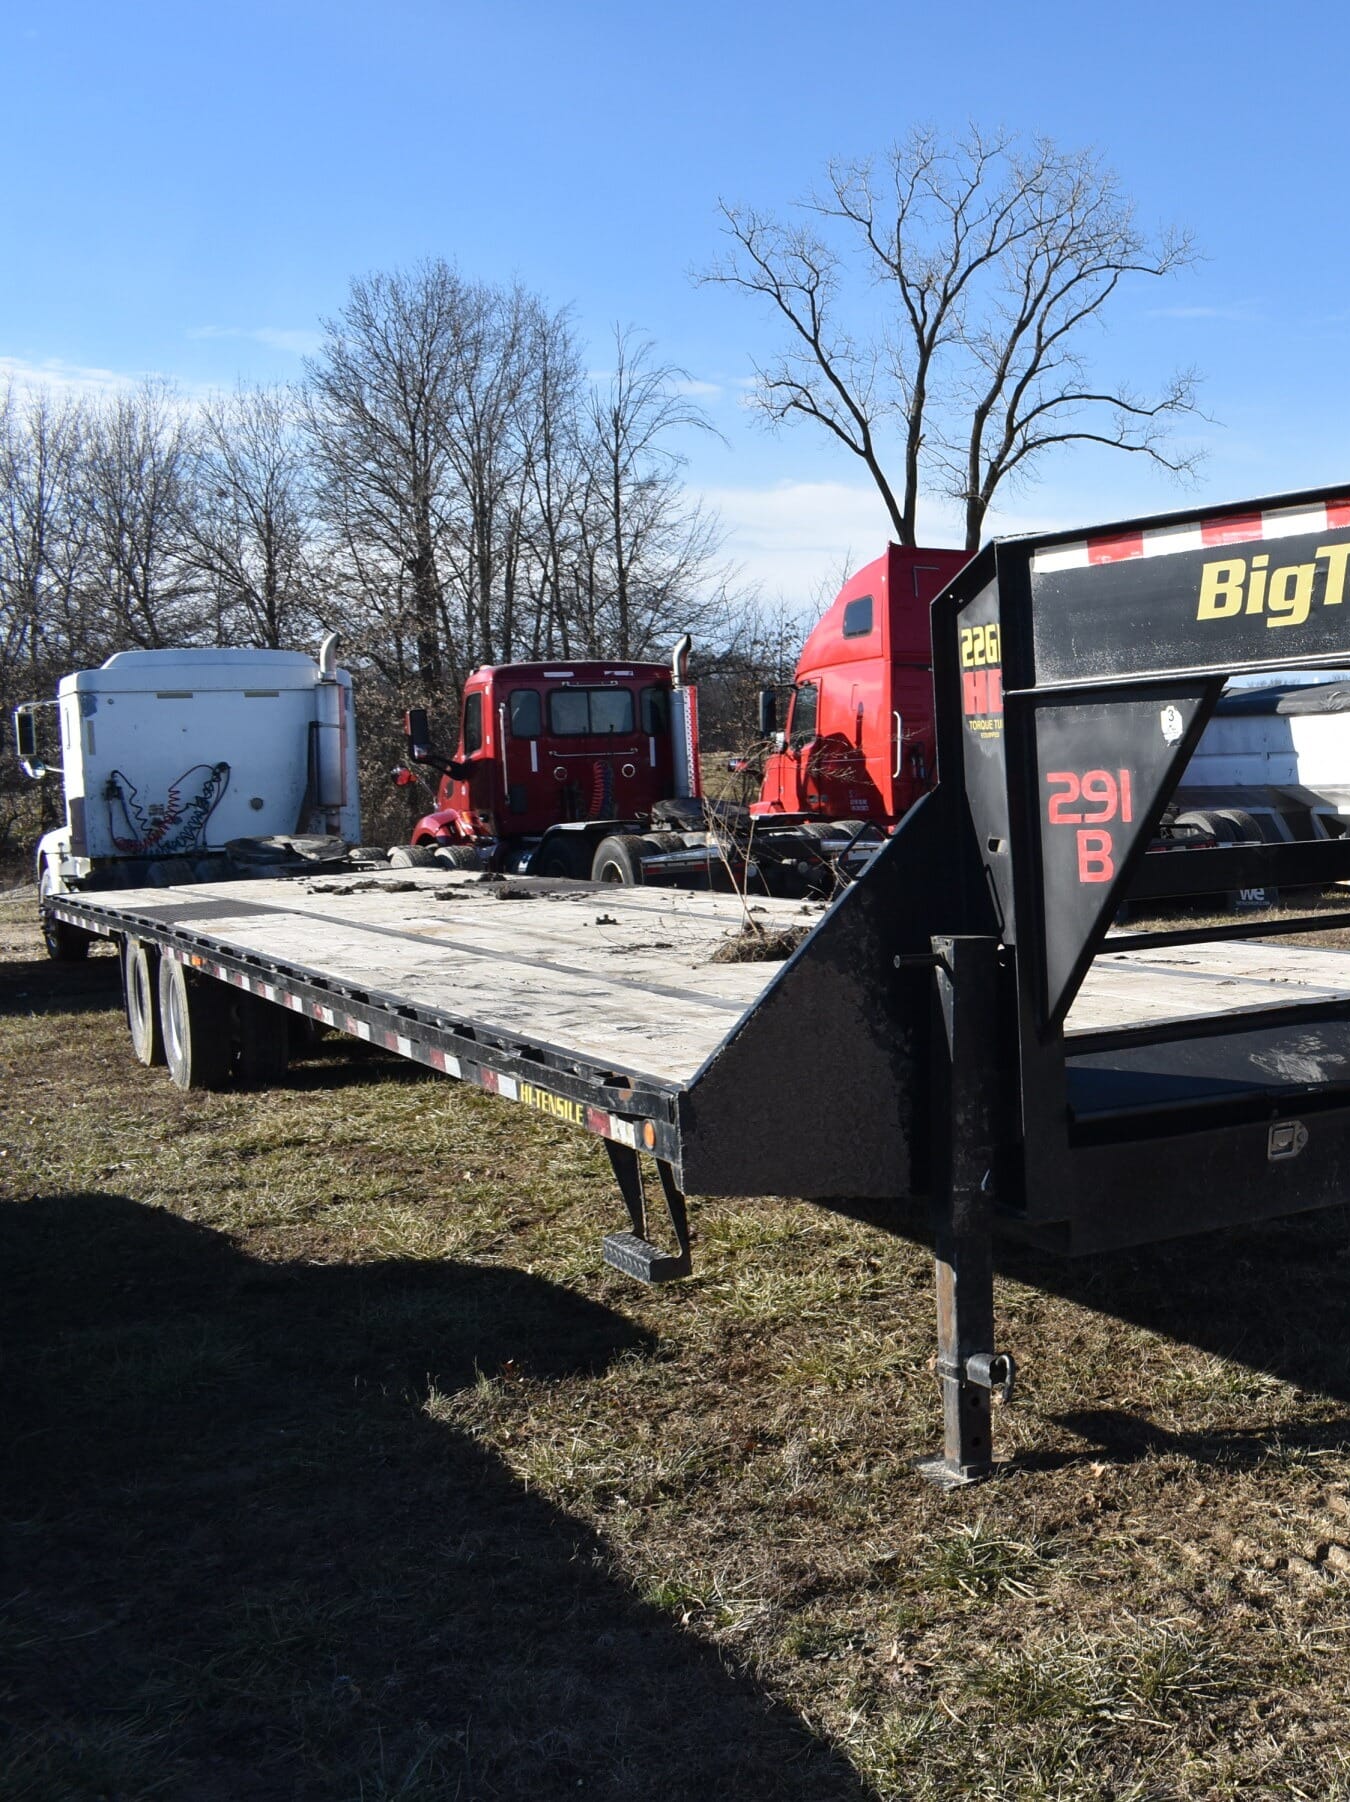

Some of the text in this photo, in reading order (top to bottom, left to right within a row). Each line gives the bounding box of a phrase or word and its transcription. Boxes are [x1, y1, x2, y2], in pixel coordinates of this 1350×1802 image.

[1046, 769, 1132, 824] 291
[1076, 829, 1114, 882] B
[520, 1082, 584, 1126] HI-TENSILE
